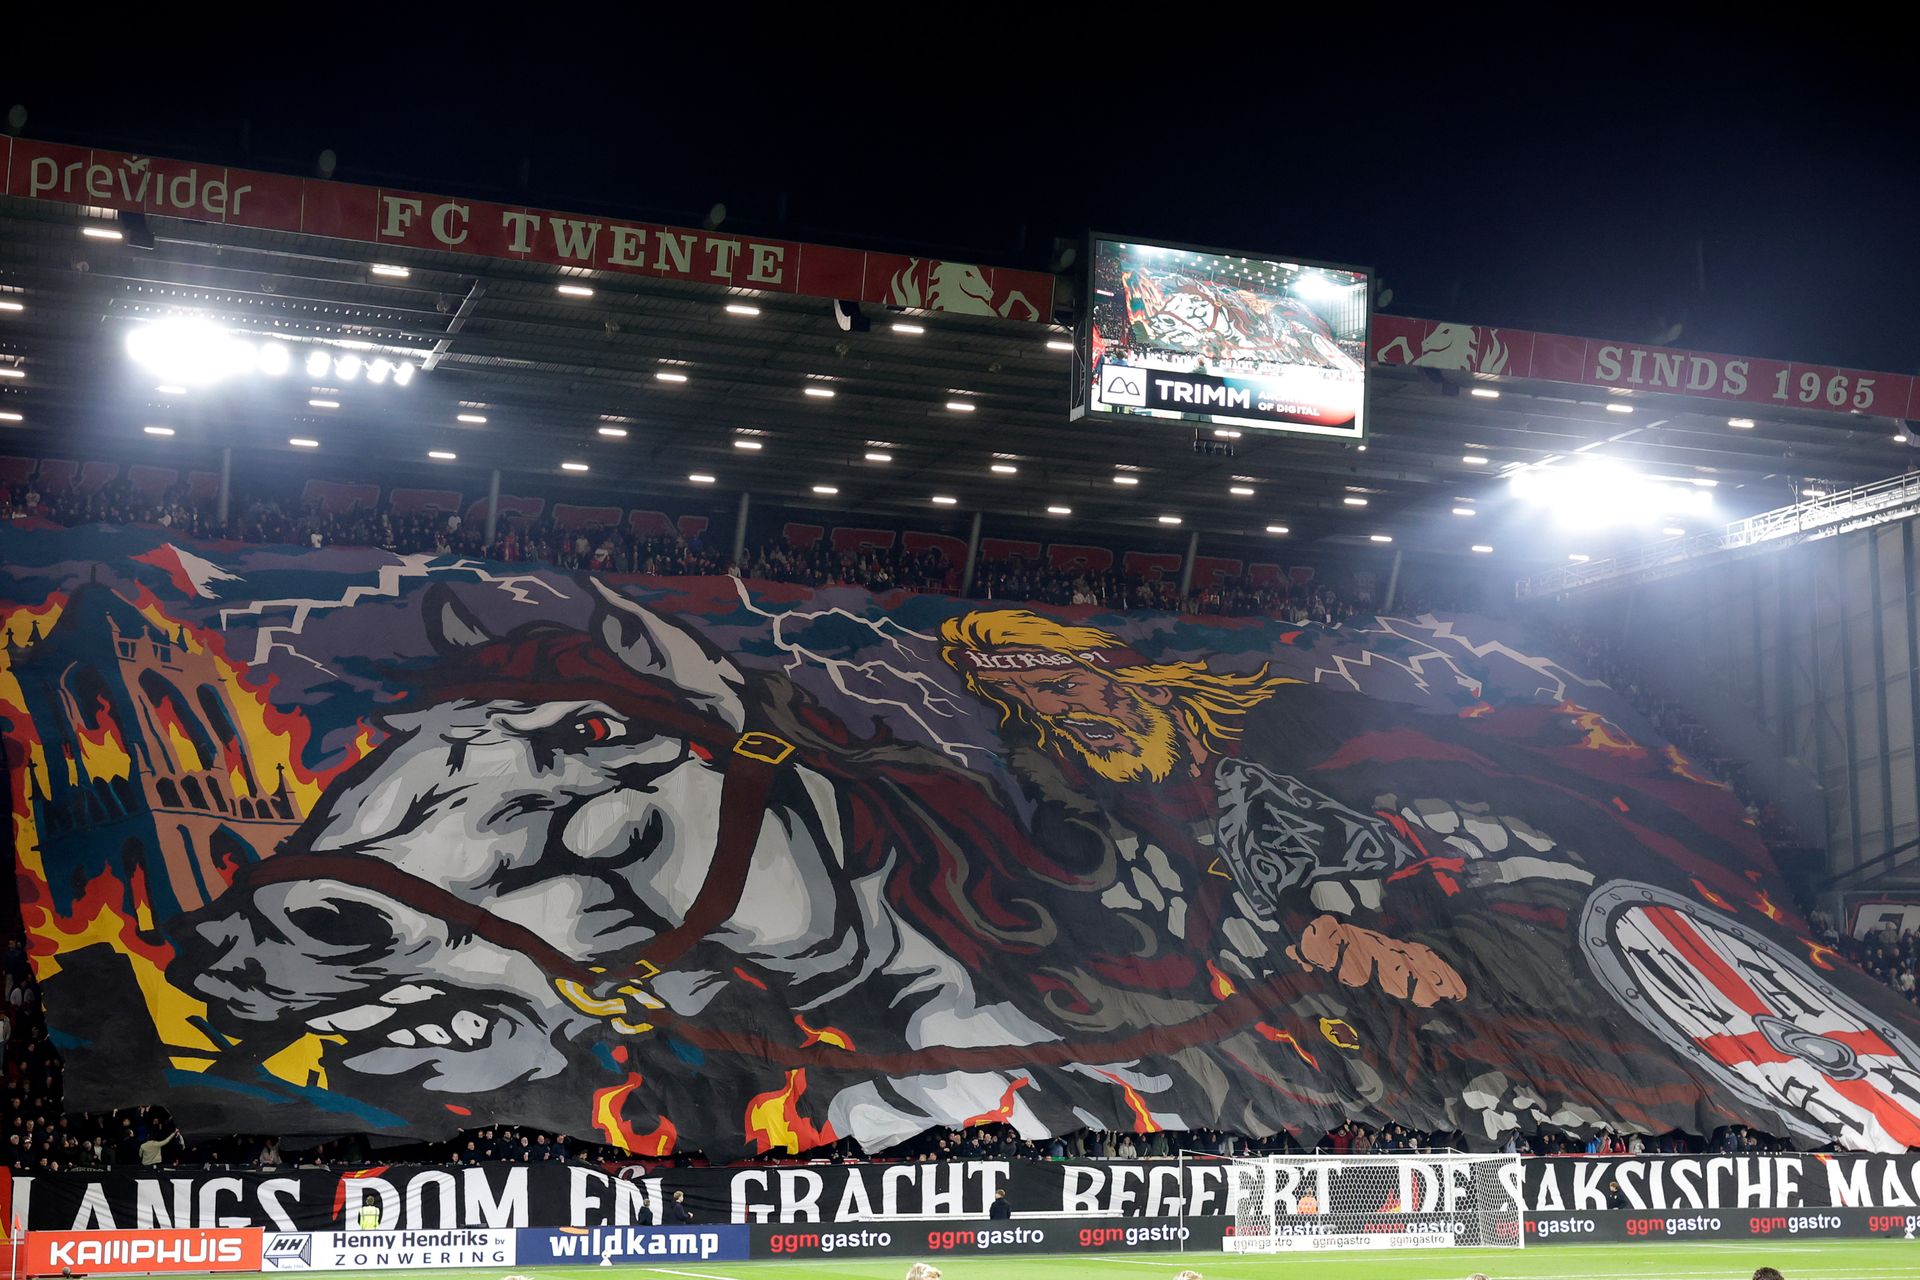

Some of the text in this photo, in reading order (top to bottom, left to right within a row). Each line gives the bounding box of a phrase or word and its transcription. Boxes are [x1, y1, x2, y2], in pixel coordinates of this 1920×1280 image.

[30, 155, 252, 216] previder
[381, 195, 784, 284] FC TWENTE
[1595, 346, 1876, 408] SINDS 1965
[1155, 379, 1250, 409] TRIMM
[1258, 401, 1320, 417] OF DIGITAL
[10, 1176, 301, 1244] LANGS
[342, 1167, 530, 1231] DOM
[568, 1166, 664, 1227] EN
[730, 1160, 1010, 1224] GRACHT
[1498, 1157, 1804, 1211] SAKSISCHE
[1825, 1159, 1920, 1208] MA
[50, 1232, 242, 1266] KAMPHUIS
[273, 1239, 303, 1251] HH
[333, 1230, 505, 1249] Henny Hendriks bv
[550, 1228, 719, 1259] wildkamp
[334, 1251, 504, 1266] ZONWERING
